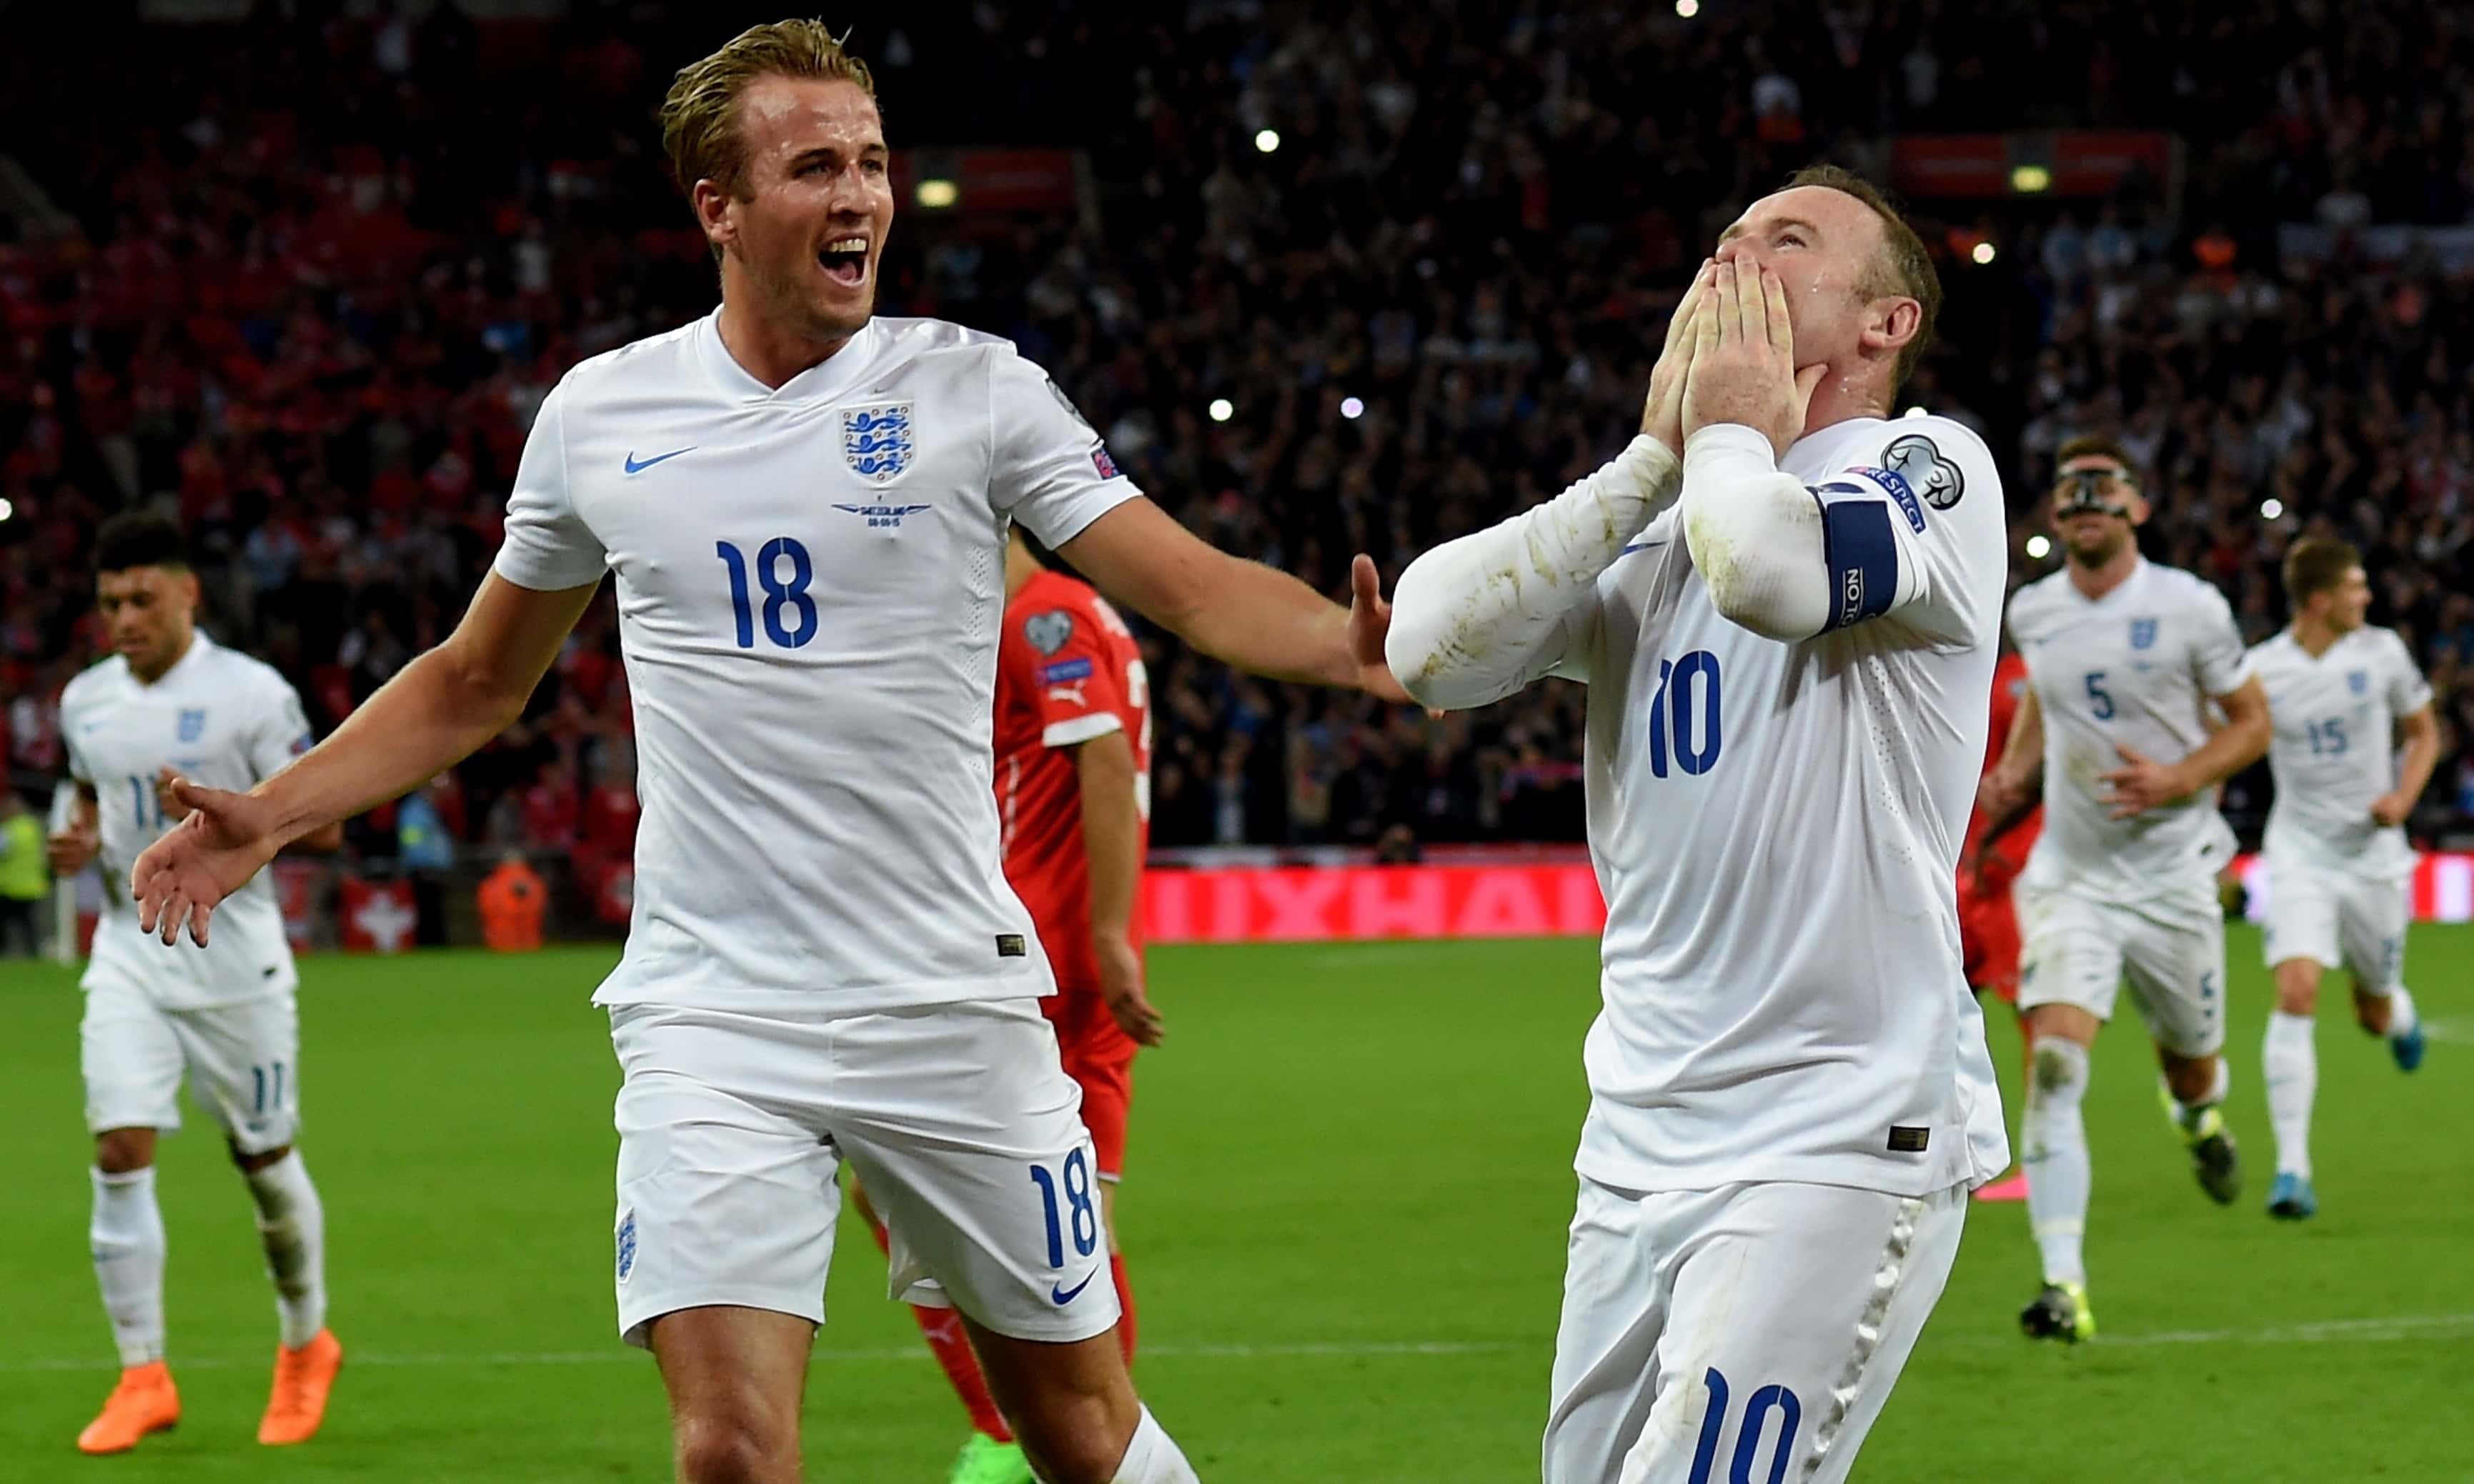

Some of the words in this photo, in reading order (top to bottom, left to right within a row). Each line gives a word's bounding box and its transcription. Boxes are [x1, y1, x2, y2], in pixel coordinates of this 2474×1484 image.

[1867, 467, 1924, 531] RESPECT
[716, 537, 818, 649] 18
[1847, 569, 1860, 601] NO
[1649, 650, 1722, 778] 10
[2084, 672, 2115, 721] 5
[2304, 717, 2348, 755] 15
[252, 1061, 284, 1113] 11
[1030, 1147, 1096, 1268] 18
[1687, 1366, 1801, 1484] 10
